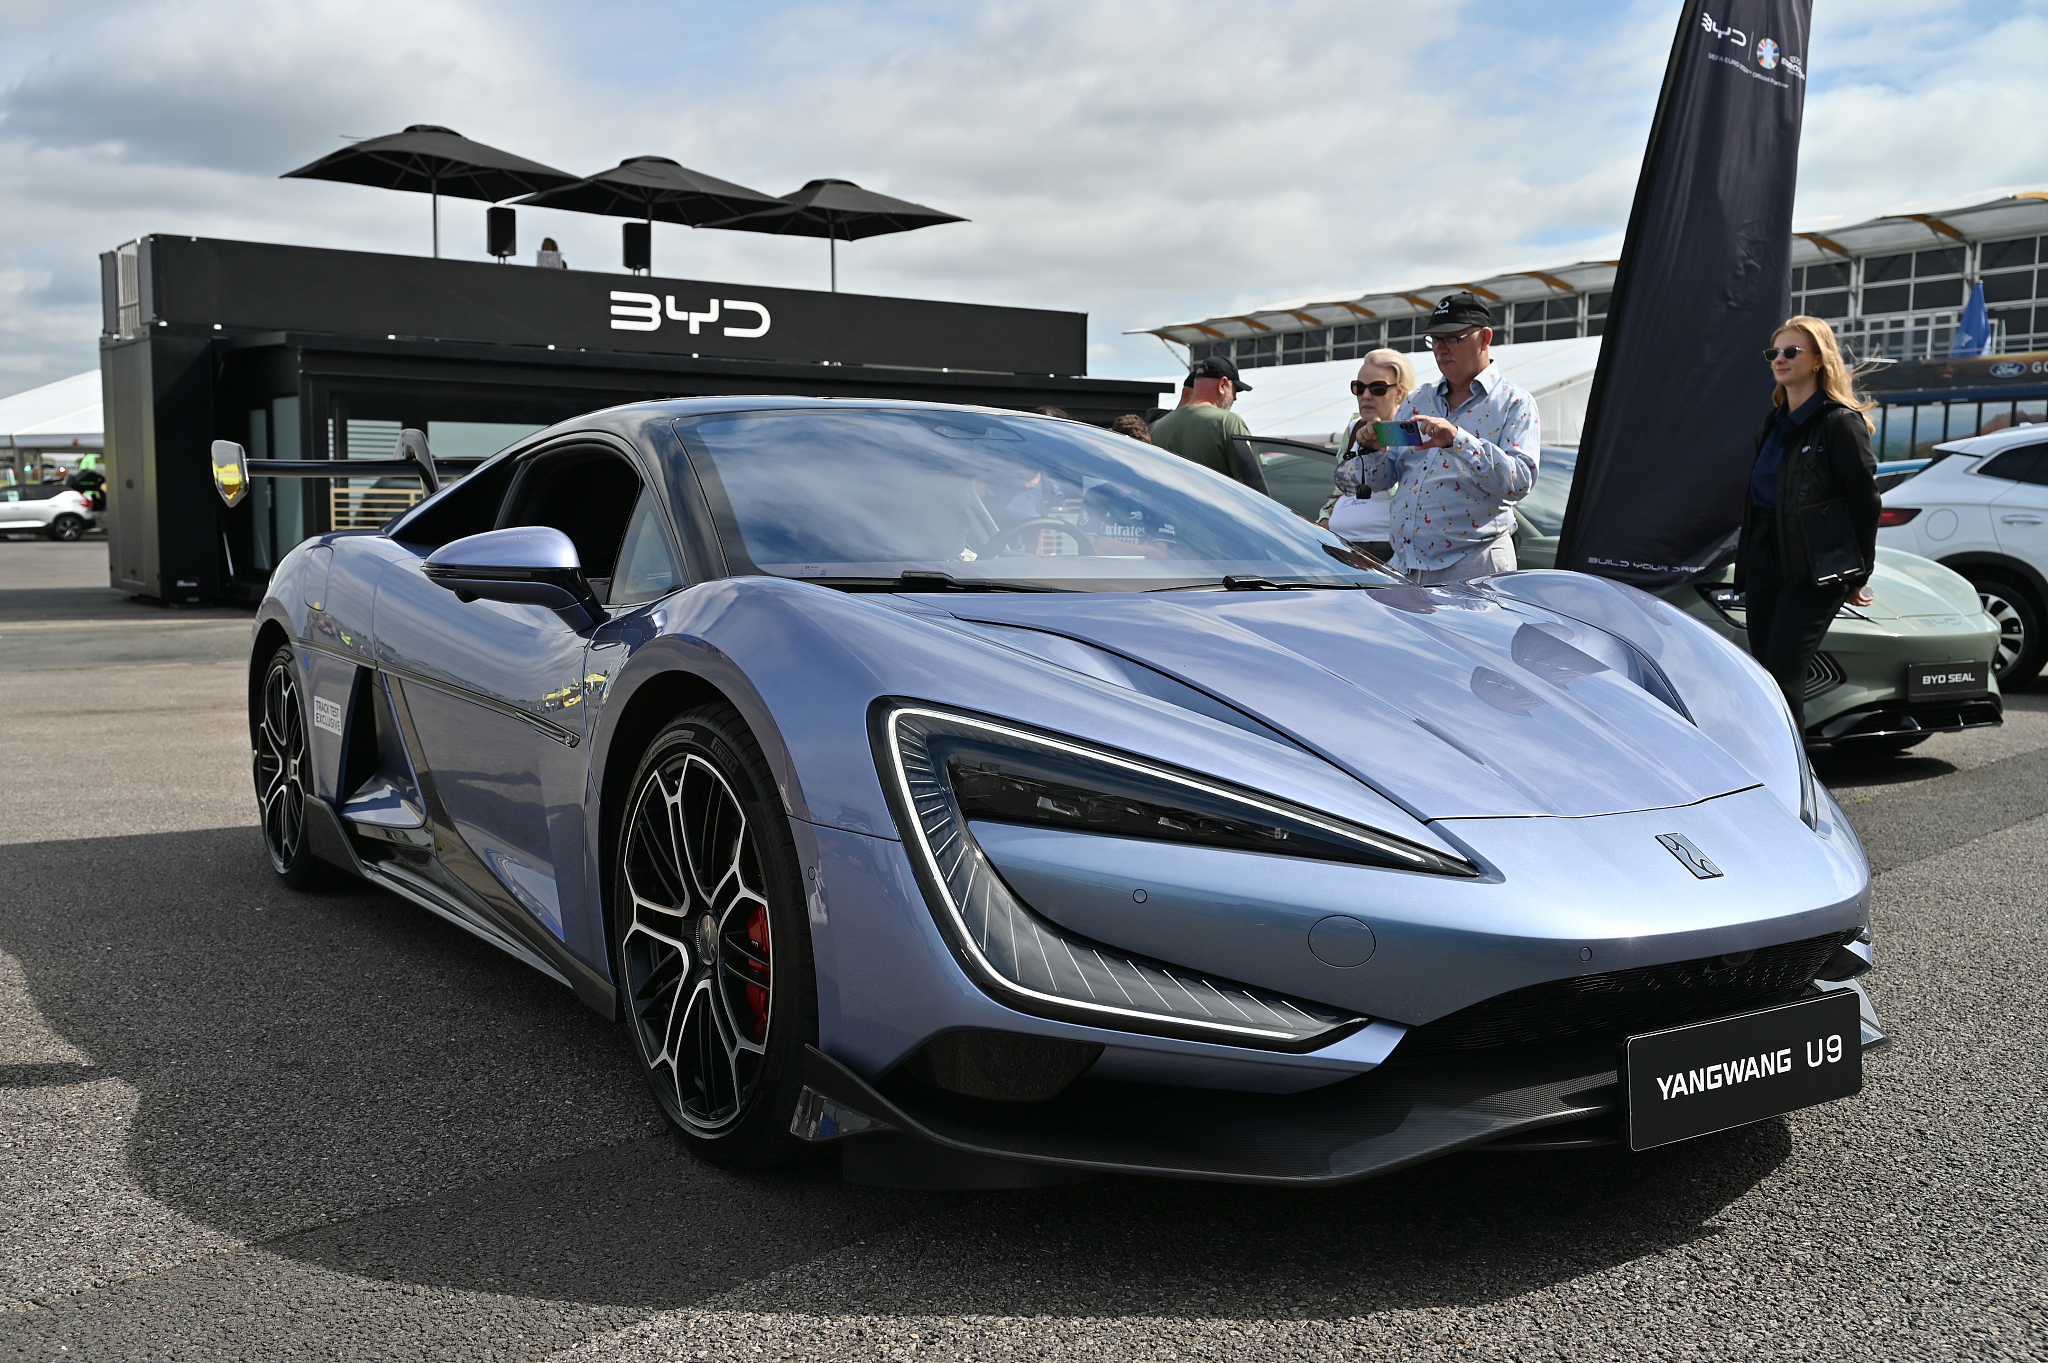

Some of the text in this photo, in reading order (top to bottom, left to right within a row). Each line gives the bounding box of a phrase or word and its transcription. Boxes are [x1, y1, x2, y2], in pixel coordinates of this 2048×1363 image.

[1701, 12, 1747, 47] BYD
[610, 290, 771, 338] BYD
[1588, 557, 1629, 567] BUILD
[1633, 562, 1668, 571] YOUR
[1922, 672, 1976, 685] BYD SEAL
[316, 700, 340, 719] TRACK TEST
[316, 712, 341, 732] EXCLUSIVE
[1656, 1034, 1842, 1101] YANGWANG U9
